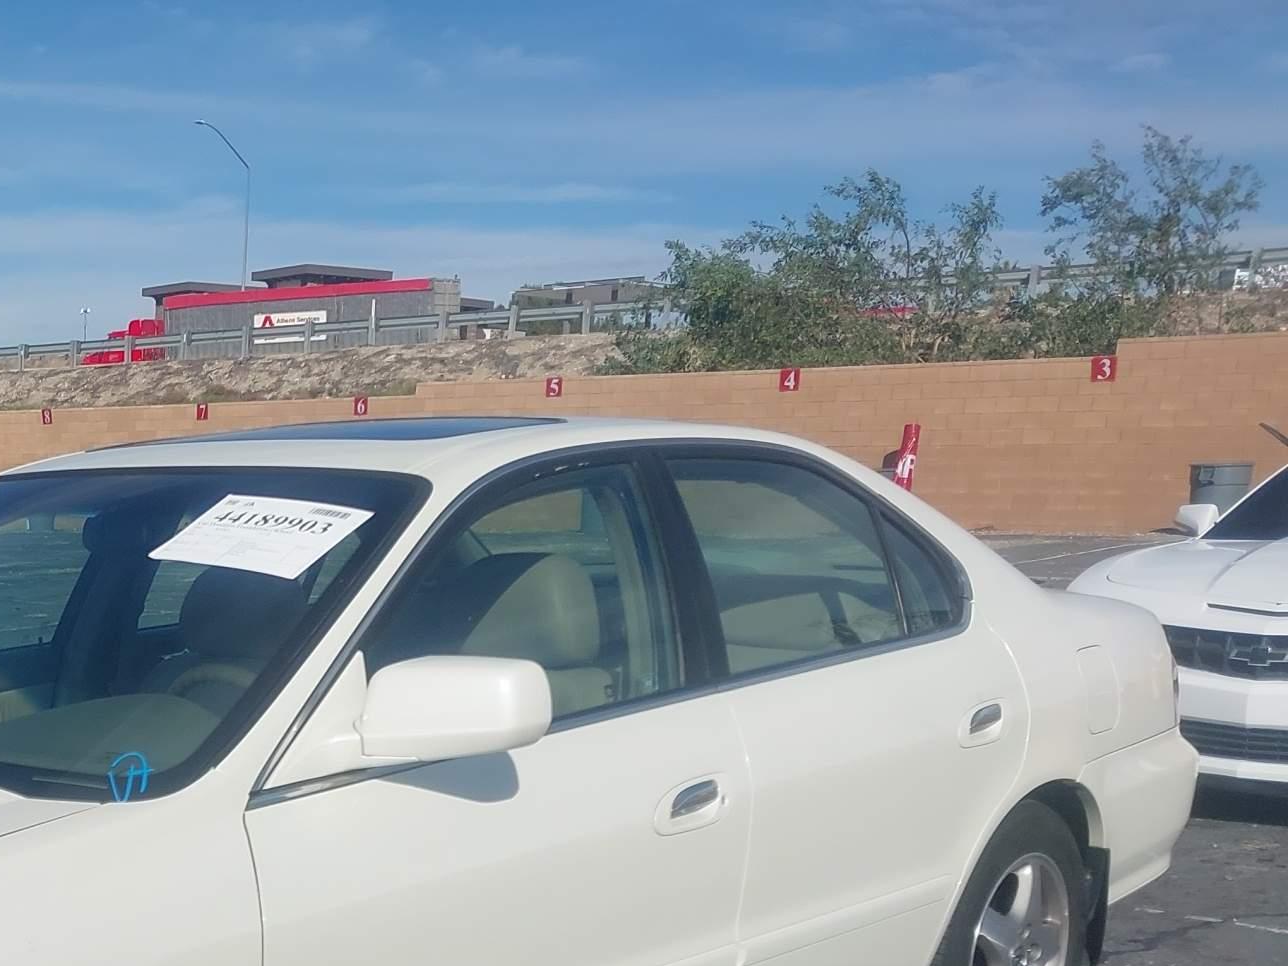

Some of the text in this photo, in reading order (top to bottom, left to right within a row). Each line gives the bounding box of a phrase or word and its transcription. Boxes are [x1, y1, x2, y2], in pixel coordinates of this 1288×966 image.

[1097, 358, 1111, 379] 3
[549, 379, 559, 396] 5
[783, 370, 795, 390] 4
[199, 404, 206, 419] 7
[357, 398, 365, 414] 6
[43, 409, 51, 424] 8
[213, 510, 333, 535] 44189903
